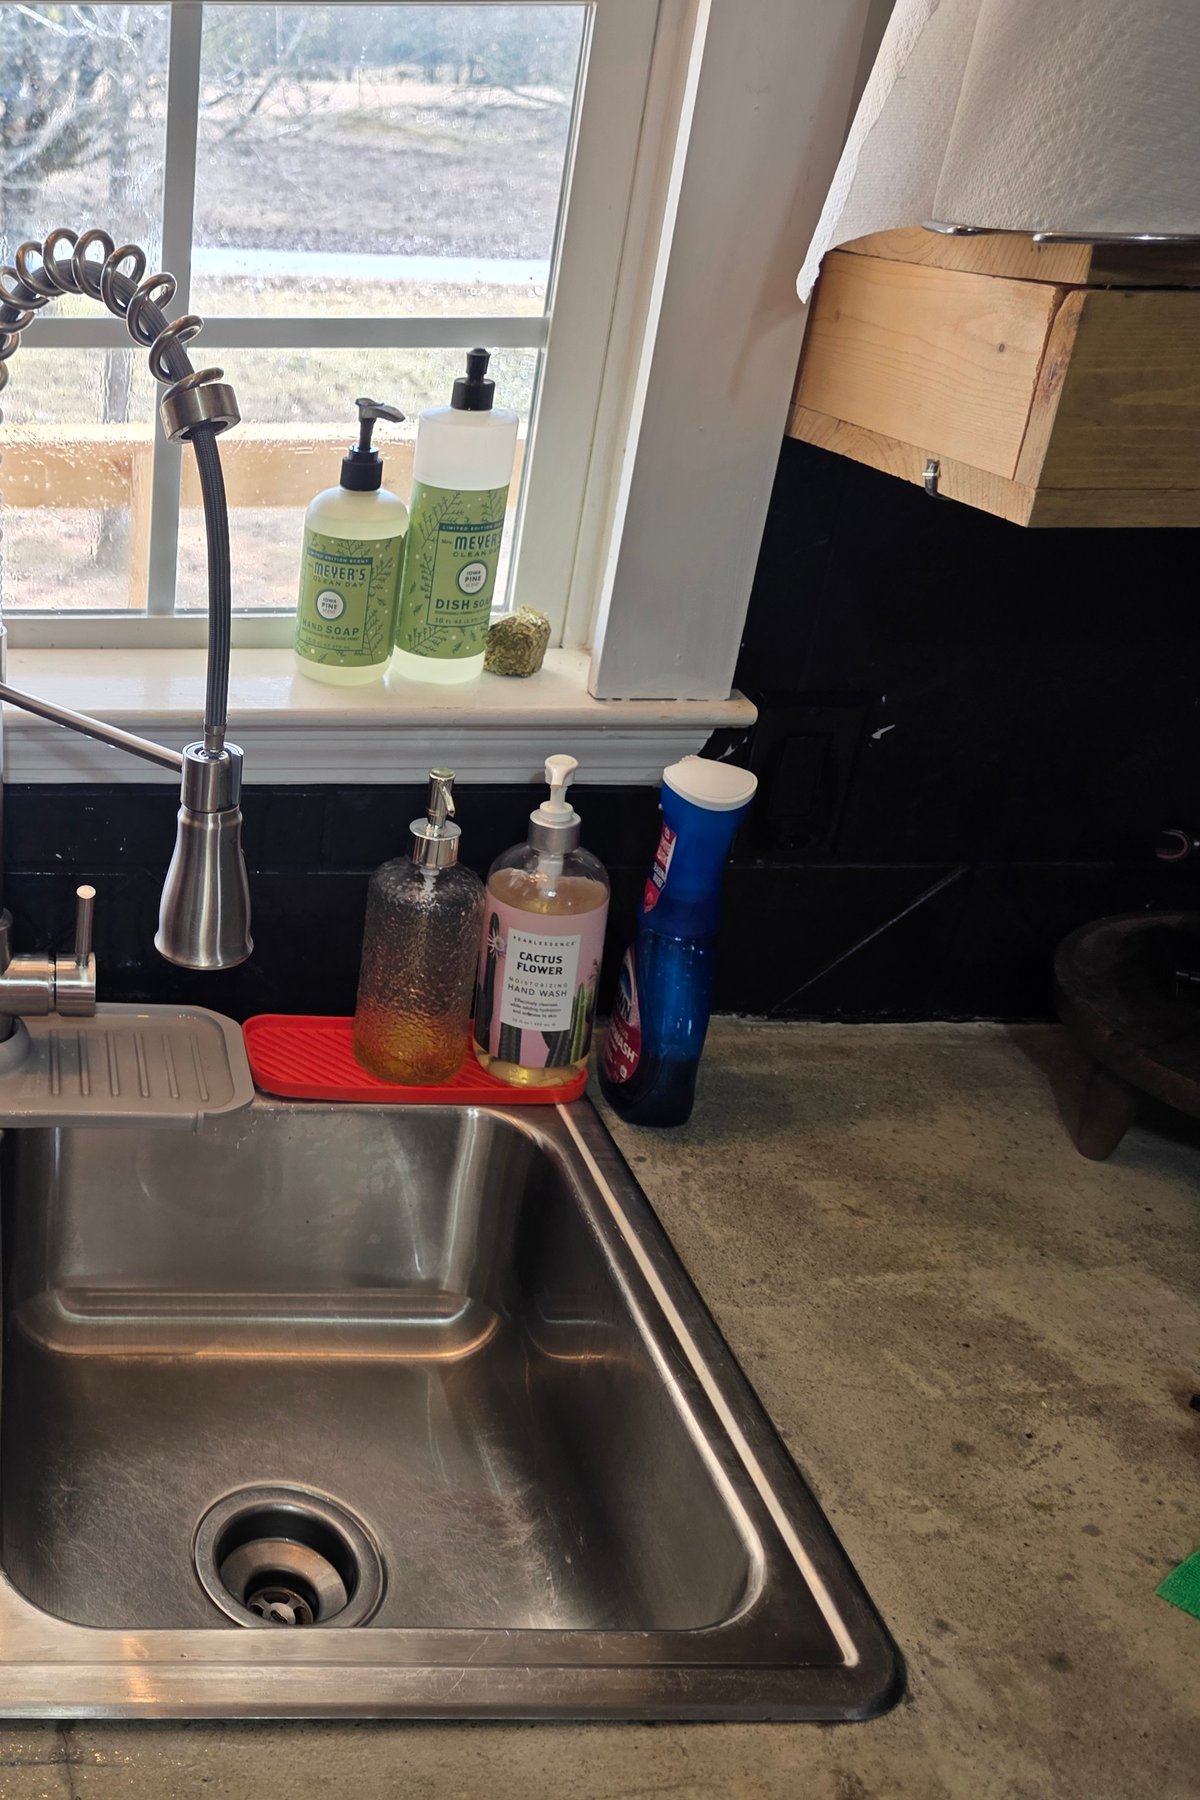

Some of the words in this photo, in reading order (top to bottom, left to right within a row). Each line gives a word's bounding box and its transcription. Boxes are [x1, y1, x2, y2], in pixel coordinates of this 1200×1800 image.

[452, 550, 487, 558] CLEAN
[314, 561, 366, 581] MEYER'S
[321, 602, 338, 610] PINE
[435, 598, 470, 610] DISH
[302, 617, 323, 632] HAND
[325, 625, 360, 636] SOAP
[512, 935, 575, 947] PEARLESSENCE
[519, 951, 563, 964] CACTUS
[516, 961, 563, 975] FLOWER
[508, 976, 568, 988] MOISTURIZING
[507, 983, 535, 996] HAND
[539, 989, 568, 998] WASH
